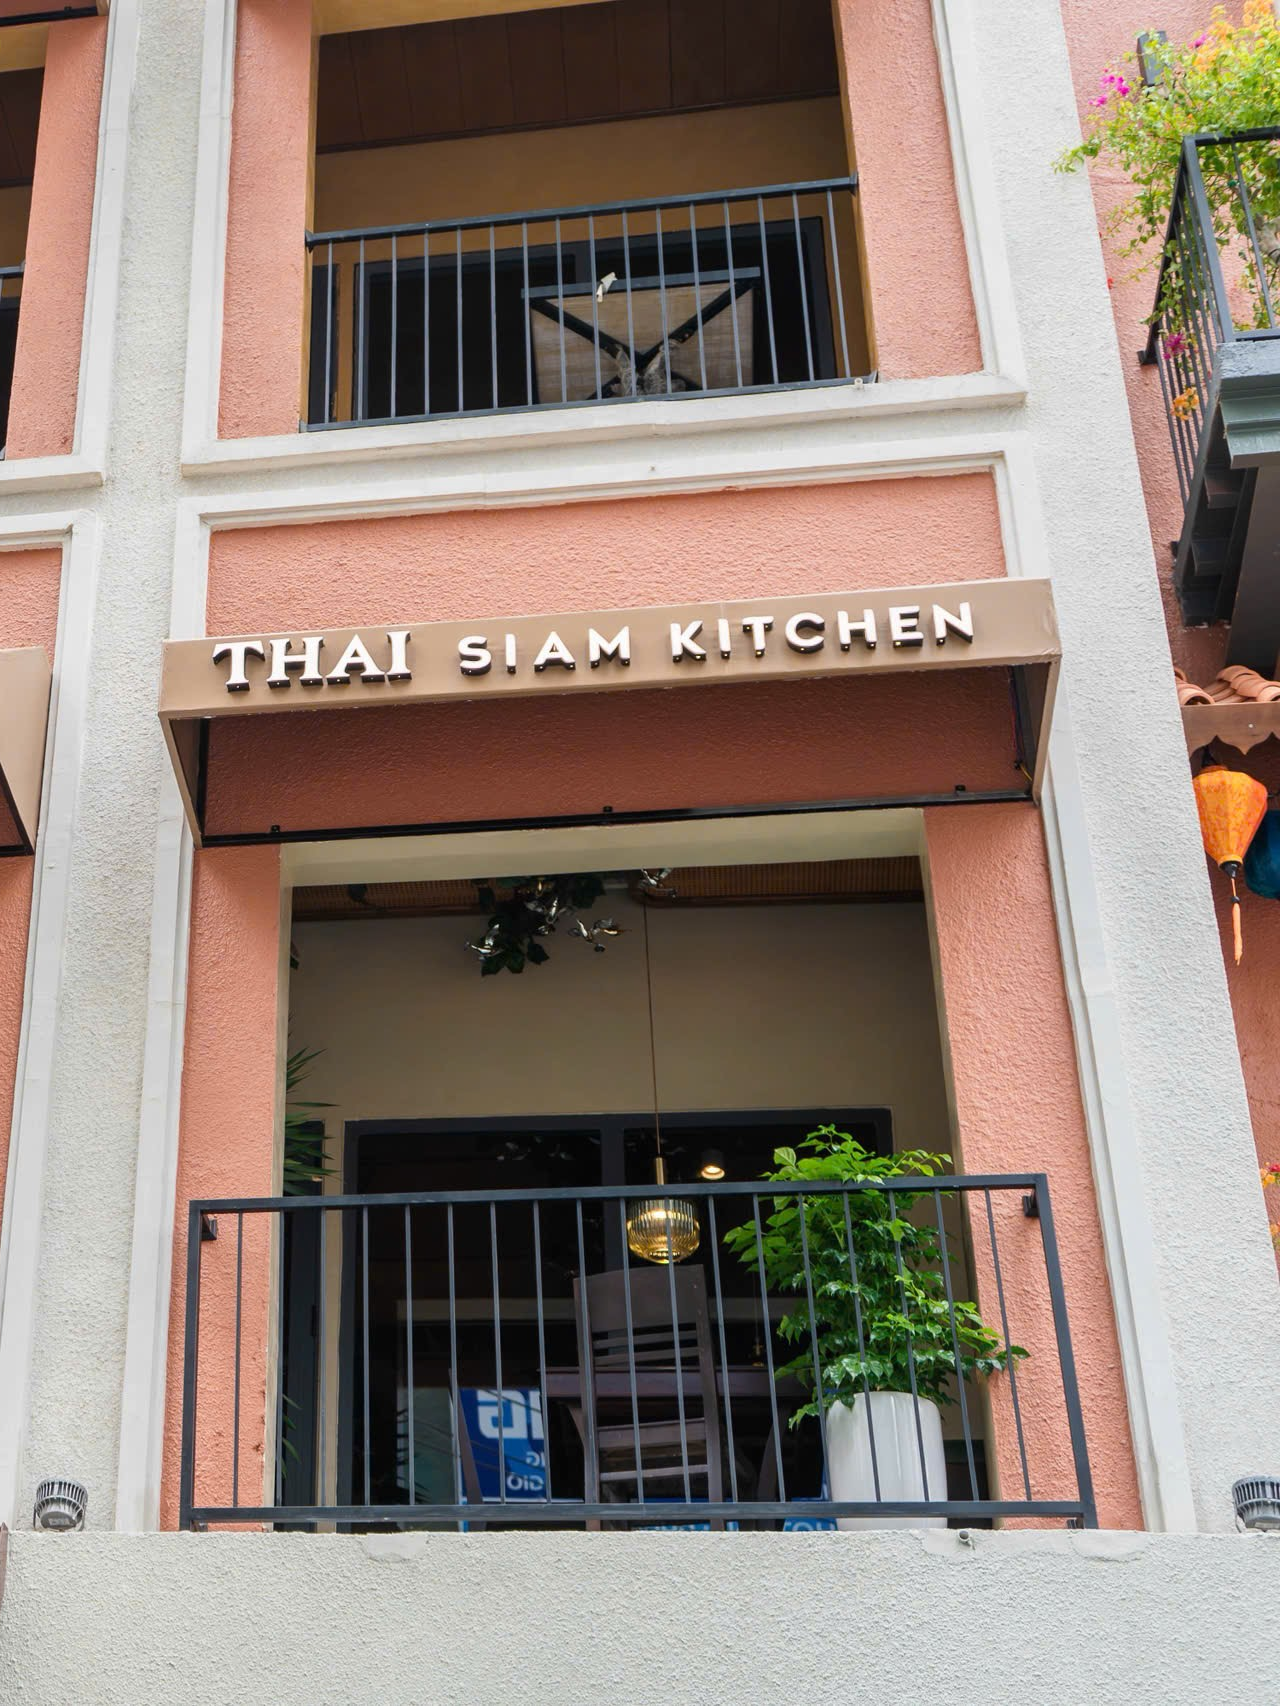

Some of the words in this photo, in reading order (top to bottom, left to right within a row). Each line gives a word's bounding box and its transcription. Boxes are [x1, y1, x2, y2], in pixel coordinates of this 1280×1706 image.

[212, 630, 412, 693] THAI
[458, 626, 631, 677] SIAM
[670, 602, 974, 662] KITCHEN
